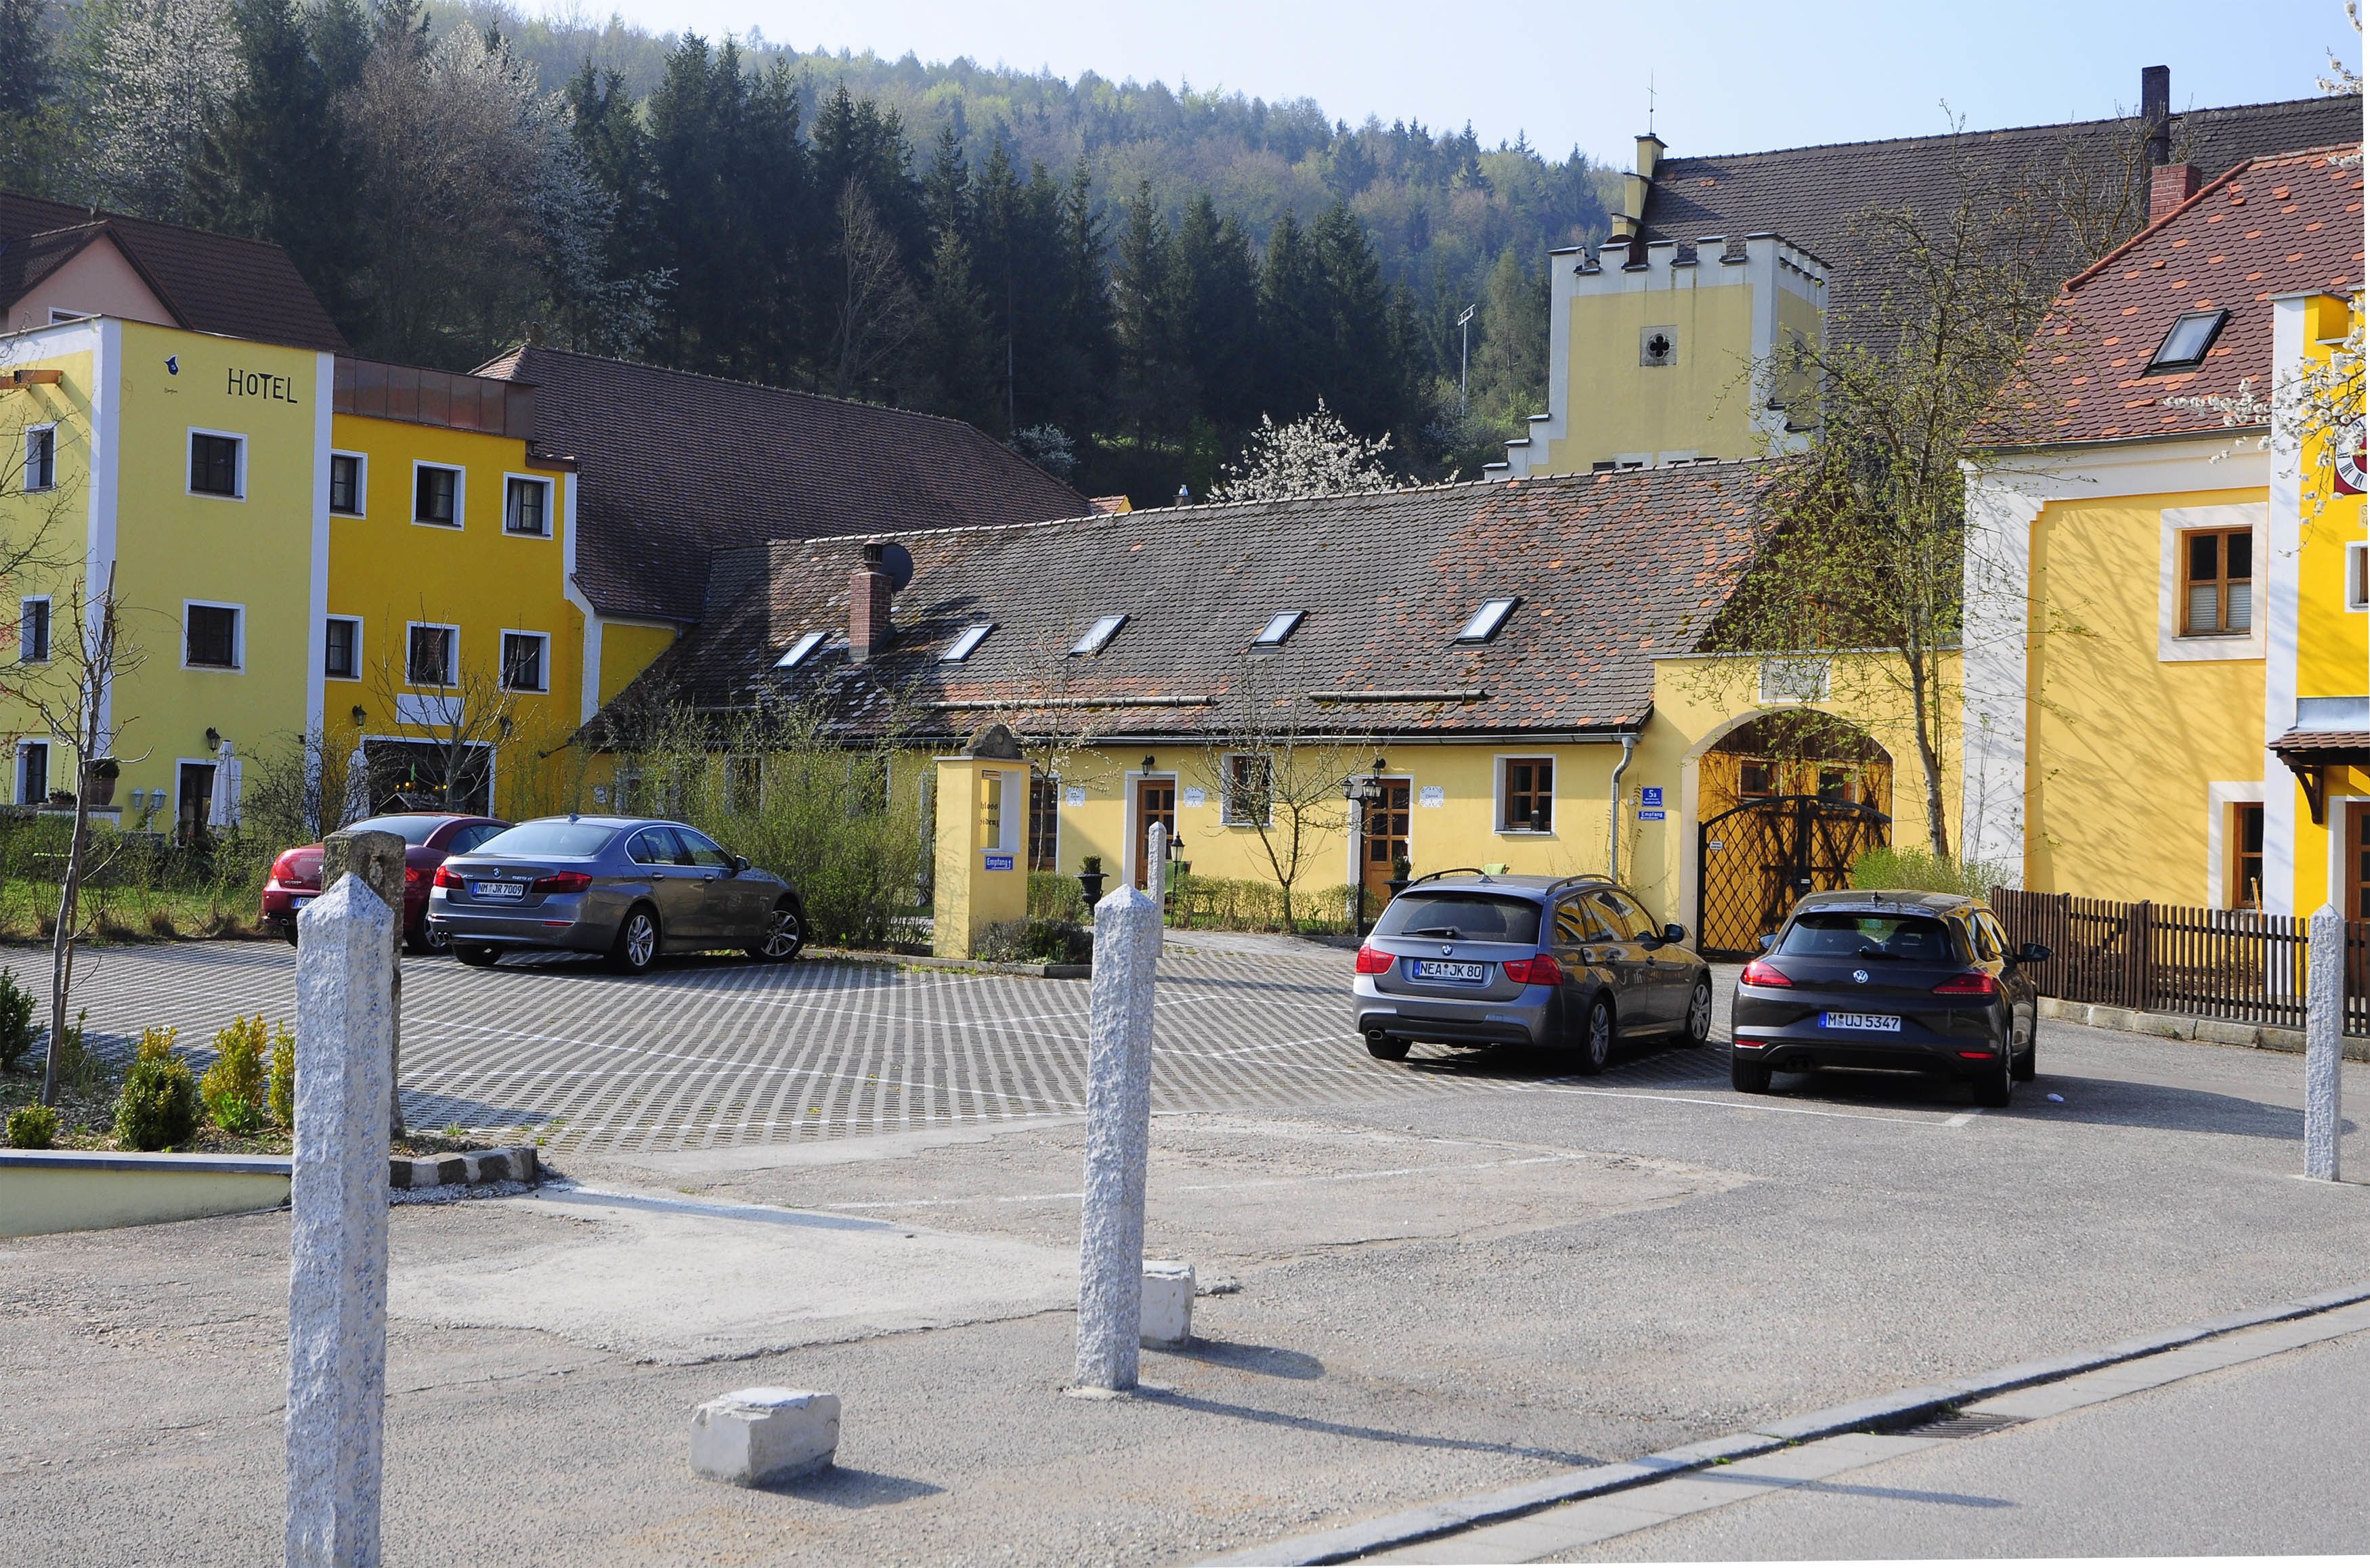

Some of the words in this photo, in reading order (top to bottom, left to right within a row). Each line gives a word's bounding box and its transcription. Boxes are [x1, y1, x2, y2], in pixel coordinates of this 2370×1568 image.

[227, 368, 298, 404] HOTEL
[987, 858, 1008, 867] Empfang
[503, 884, 522, 894] 7009
[1420, 963, 1442, 975] NEA
[1450, 965, 1465, 976] JK
[1467, 965, 1482, 978] 80
[1828, 1014, 1836, 1026] M
[1845, 1015, 1862, 1027] UJ
[1866, 1016, 1899, 1029] 5347
